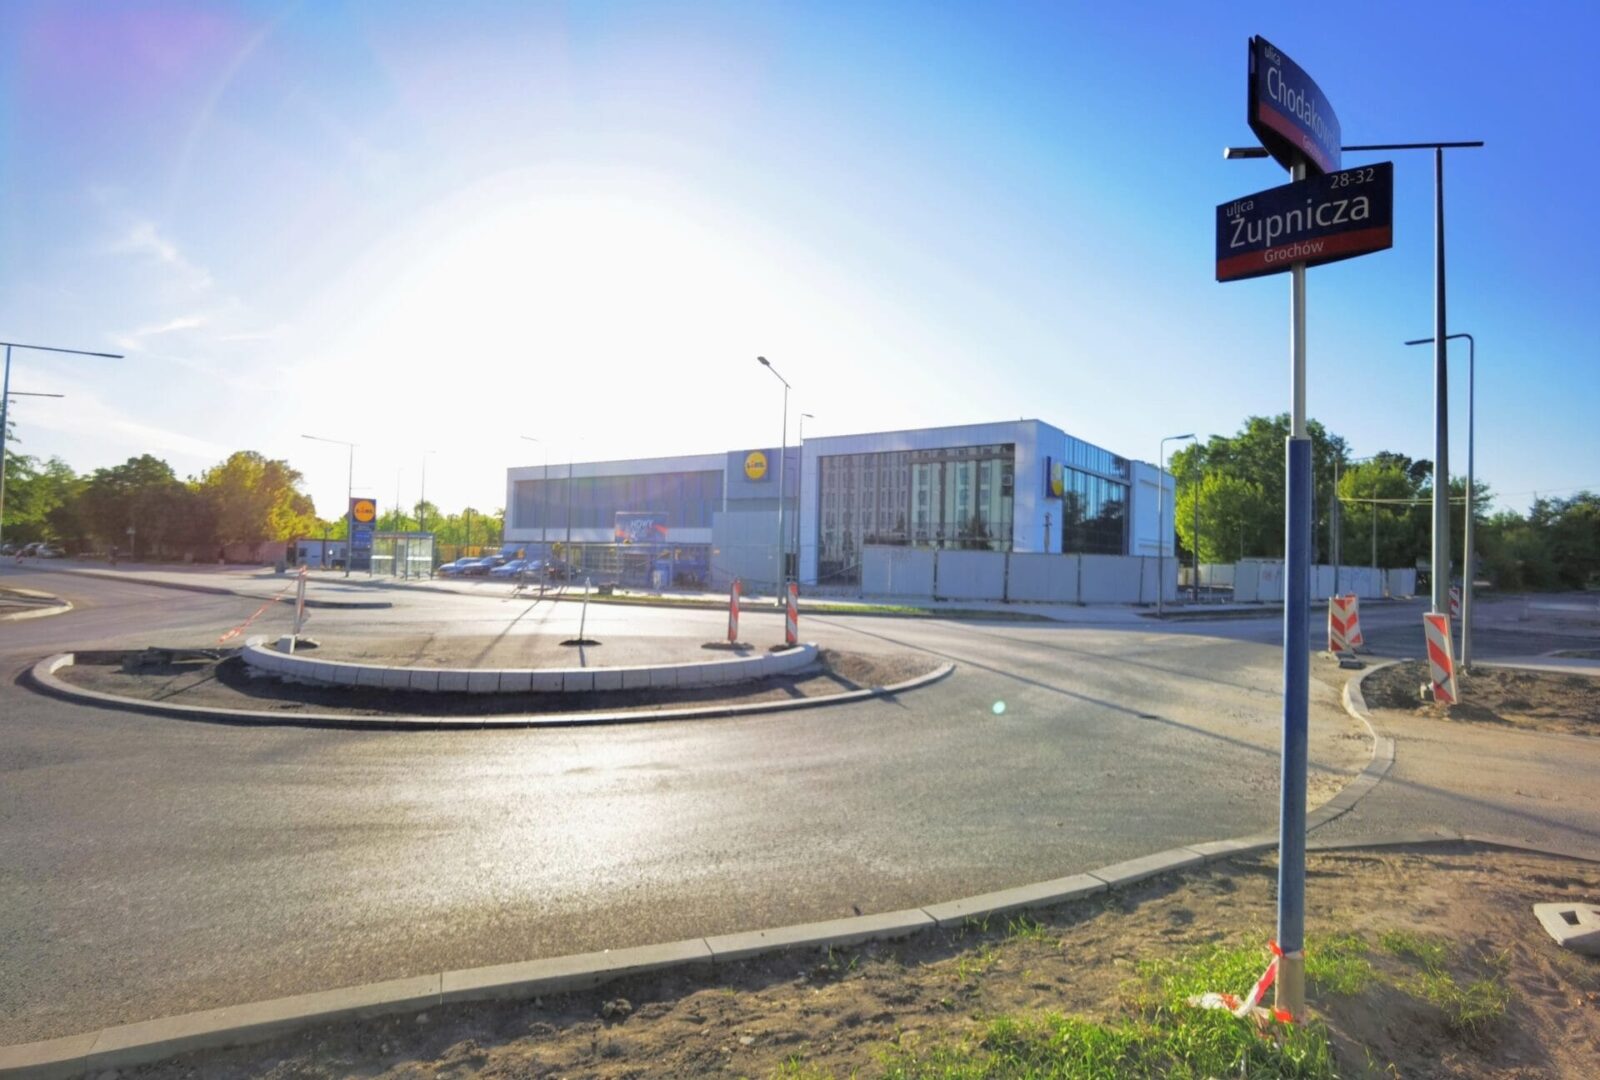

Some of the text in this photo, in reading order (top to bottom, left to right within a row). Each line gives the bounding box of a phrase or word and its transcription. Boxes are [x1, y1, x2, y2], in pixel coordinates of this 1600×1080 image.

[1330, 167, 1375, 189] 28-32
[1226, 200, 1254, 218] ulica
[1230, 195, 1370, 248] Żupnicza
[1264, 240, 1324, 264] Grochów
